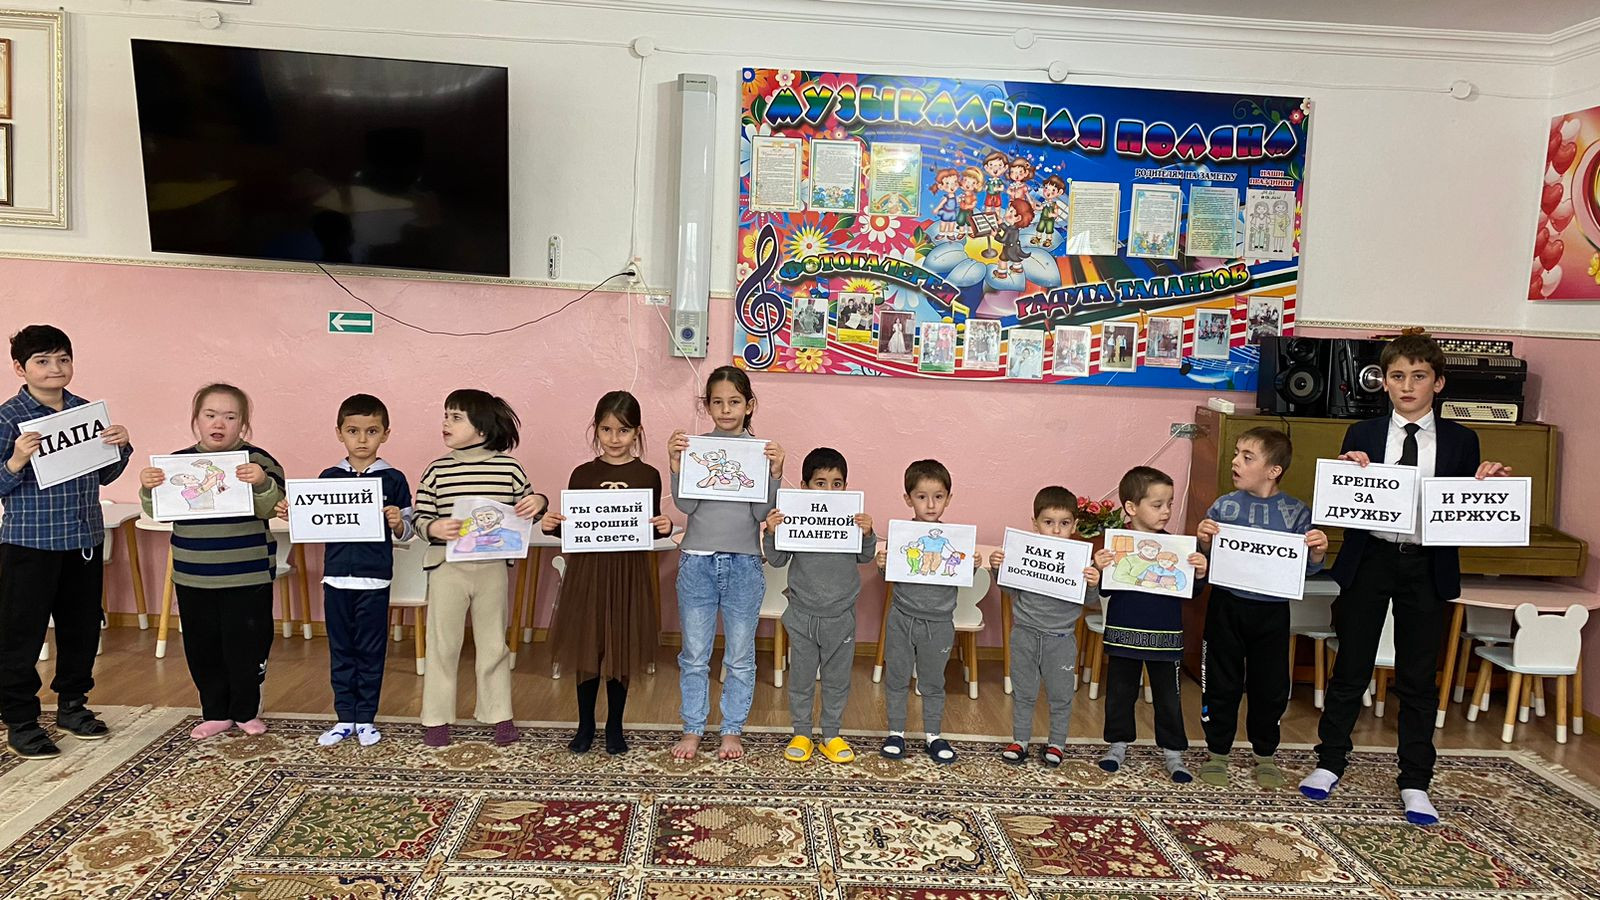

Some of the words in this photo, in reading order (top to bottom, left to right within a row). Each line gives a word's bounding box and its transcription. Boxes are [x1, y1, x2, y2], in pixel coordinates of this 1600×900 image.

[763, 83, 1105, 150] МУЗЫКАЛЬНАЯ
[1115, 119, 1297, 160] ПОЛЯНА
[1135, 168, 1184, 180] РОДИТЕЛЯМ
[1185, 171, 1199, 180] НА
[1200, 172, 1238, 182] ЗАМЕТКУ
[779, 251, 961, 306] ФОТОГАЛЕРЕЯ
[1016, 282, 1114, 321] РАДУГА
[1115, 262, 1249, 301] ТАЛАНТОВ
[37, 419, 105, 457] ПАПА
[1332, 474, 1400, 490] КРЕПКО
[294, 488, 374, 506] ЛУЧШИЙ
[1354, 492, 1375, 504] ЗА
[1441, 492, 1455, 504] И
[1460, 492, 1510, 504] РУКУ
[569, 506, 591, 514] ты
[595, 501, 643, 514] самый
[810, 503, 829, 513] НА
[1325, 505, 1402, 523] ДРУЖБУ
[311, 513, 361, 526] ОТЕЦ
[574, 516, 639, 531] хороший
[783, 514, 855, 527] ОГРОМНОЙ
[1429, 510, 1521, 523] ДЕРЖУСЬ
[574, 535, 592, 543] на
[595, 533, 640, 543] свете,
[788, 529, 849, 540] ПЛАНЕТЕ
[1025, 544, 1053, 559] КАК
[1055, 551, 1066, 561] Я
[1218, 537, 1299, 560] ГОРЖУСЬ
[1021, 557, 1067, 575] ТОБОЙ
[1007, 565, 1078, 587] ВОСХИЩАЮСЬ
